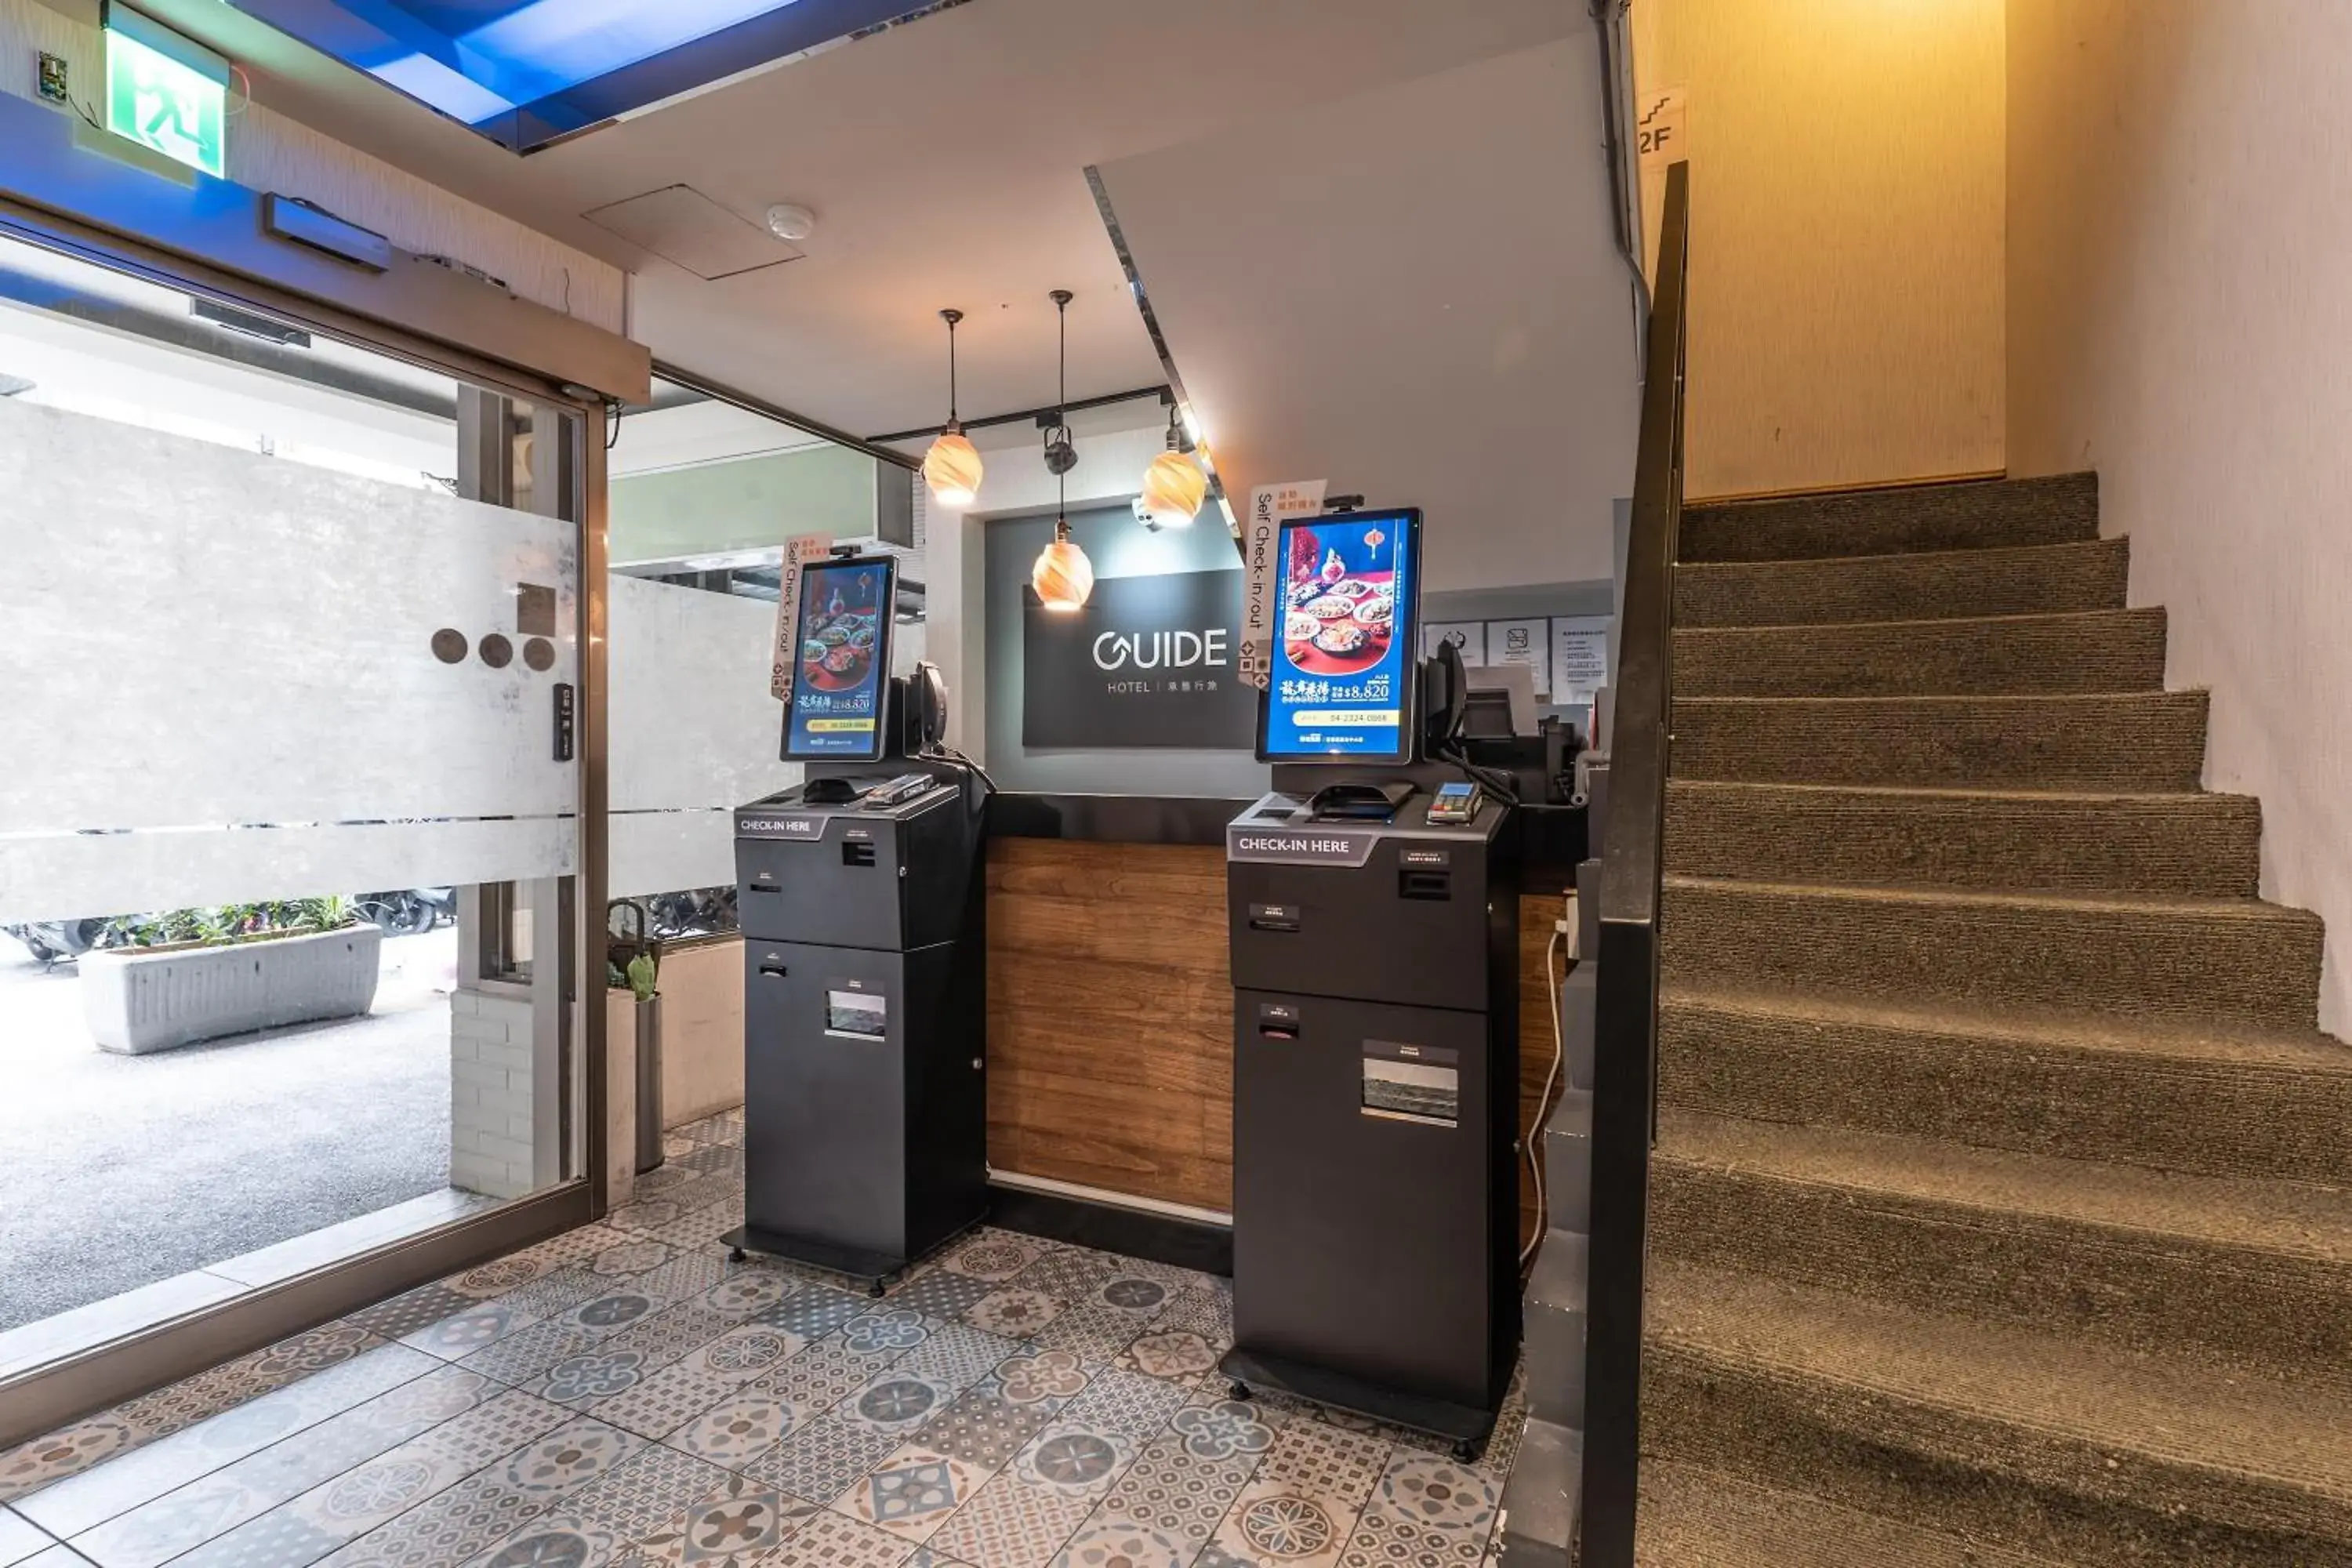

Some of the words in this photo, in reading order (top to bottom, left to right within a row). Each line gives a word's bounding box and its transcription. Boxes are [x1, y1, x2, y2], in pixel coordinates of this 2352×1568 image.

[1639, 126, 1671, 154] 2F
[1258, 492, 1272, 523] Self
[1250, 526, 1270, 630] Check-in/out
[1092, 628, 1227, 670] GUIDE
[1106, 681, 1151, 694] HOTEL
[1239, 838, 1307, 852] CHECK-IN
[1312, 840, 1349, 854] HERE
